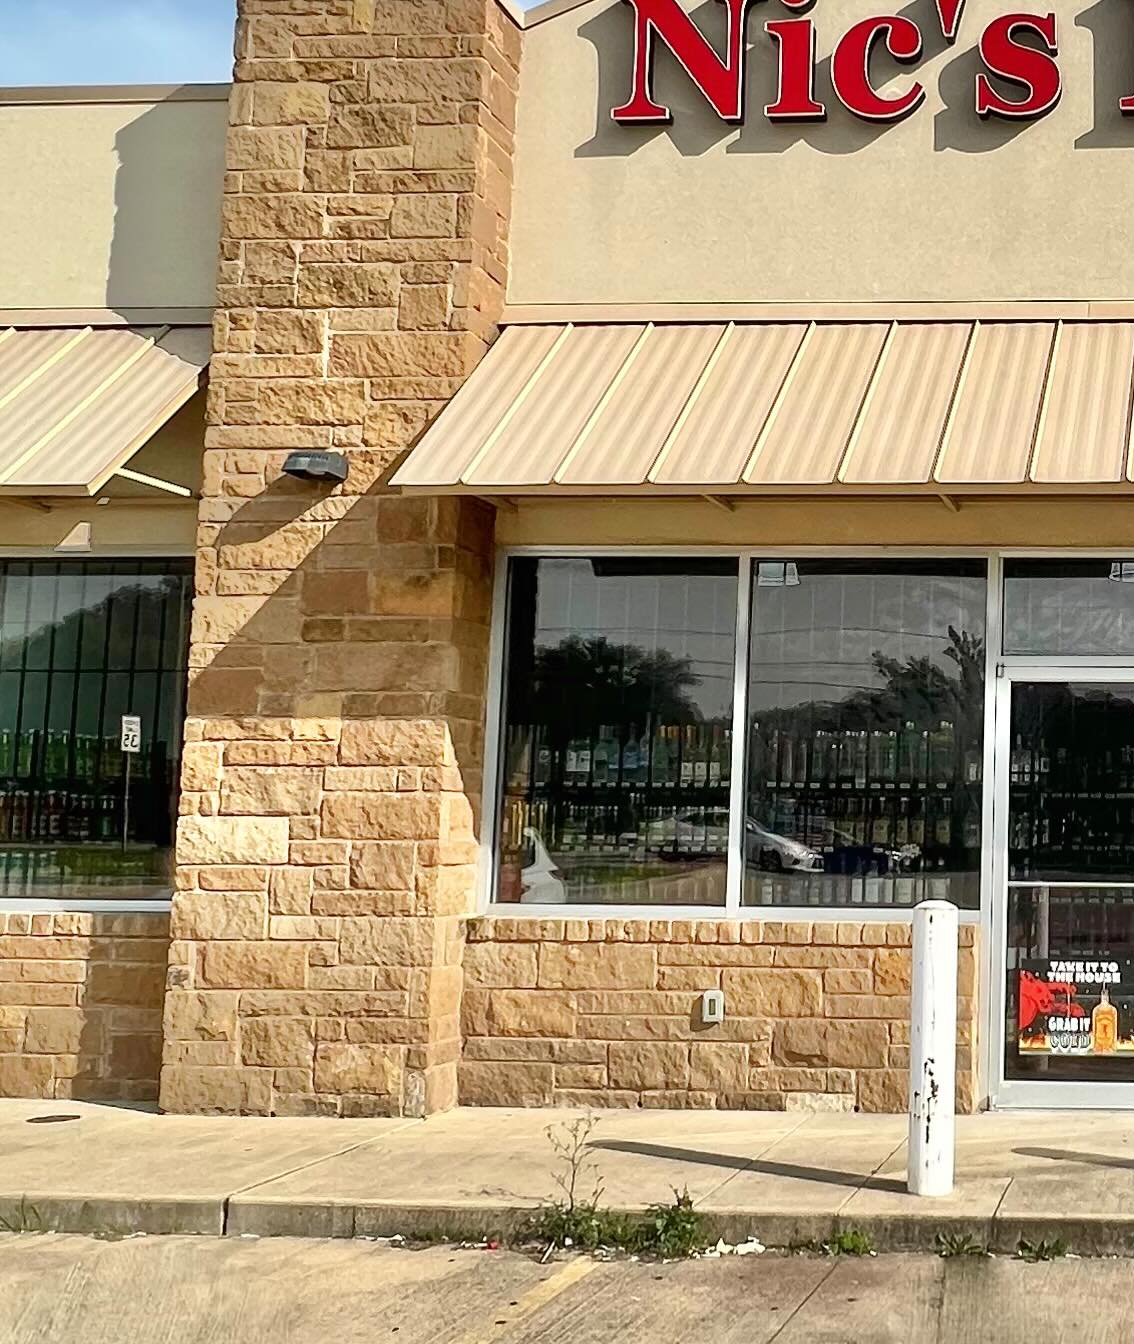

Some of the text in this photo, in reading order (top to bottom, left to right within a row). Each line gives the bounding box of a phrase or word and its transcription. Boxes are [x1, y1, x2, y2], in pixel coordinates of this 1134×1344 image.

[1050, 961, 1084, 972] TAKE
[1101, 962, 1119, 972] TO
[1047, 972, 1121, 983] THE HOUSE
[1048, 1017, 1091, 1031] GRAB IT
